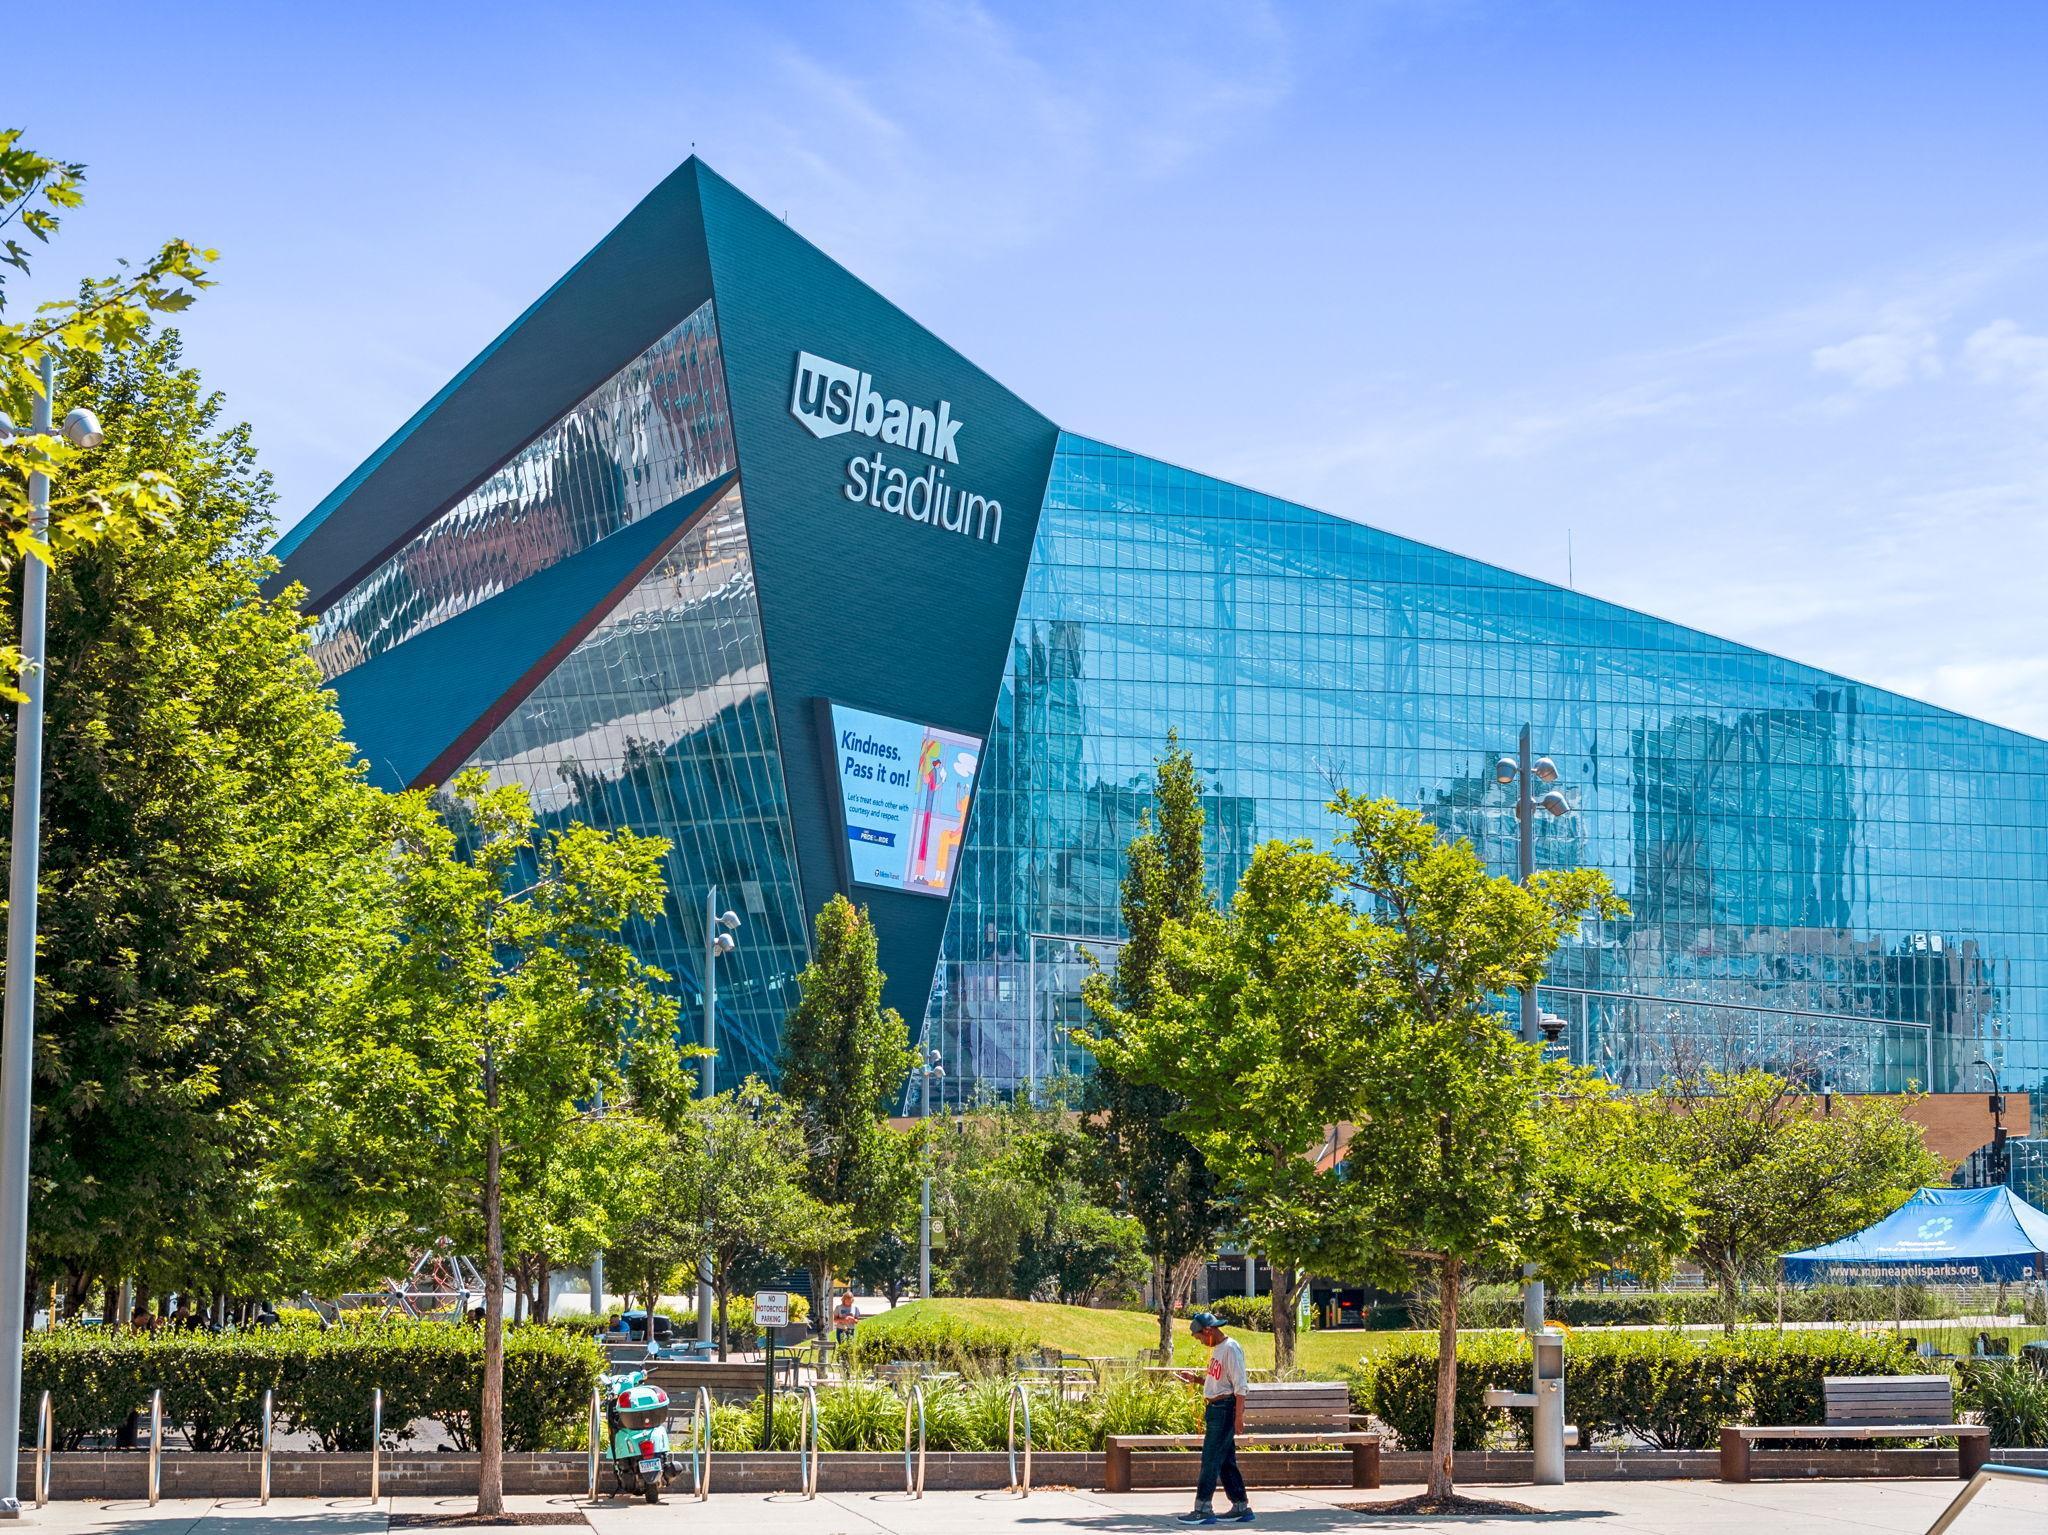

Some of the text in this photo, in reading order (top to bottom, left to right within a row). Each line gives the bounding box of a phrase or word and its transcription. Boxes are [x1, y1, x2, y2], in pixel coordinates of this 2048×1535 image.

[844, 452, 1002, 544] stadium
[841, 730, 901, 761] Kindness.
[845, 756, 911, 788] Pass it on!
[847, 793, 910, 812] Let's treat each other with
[848, 806, 870, 818] courtesy
[870, 809, 881, 818] and
[1829, 1264, 1979, 1279] www.minneapolisparks.org
[756, 1305, 787, 1313] MOTORCYCLE
[760, 1315, 781, 1323] PARKING
